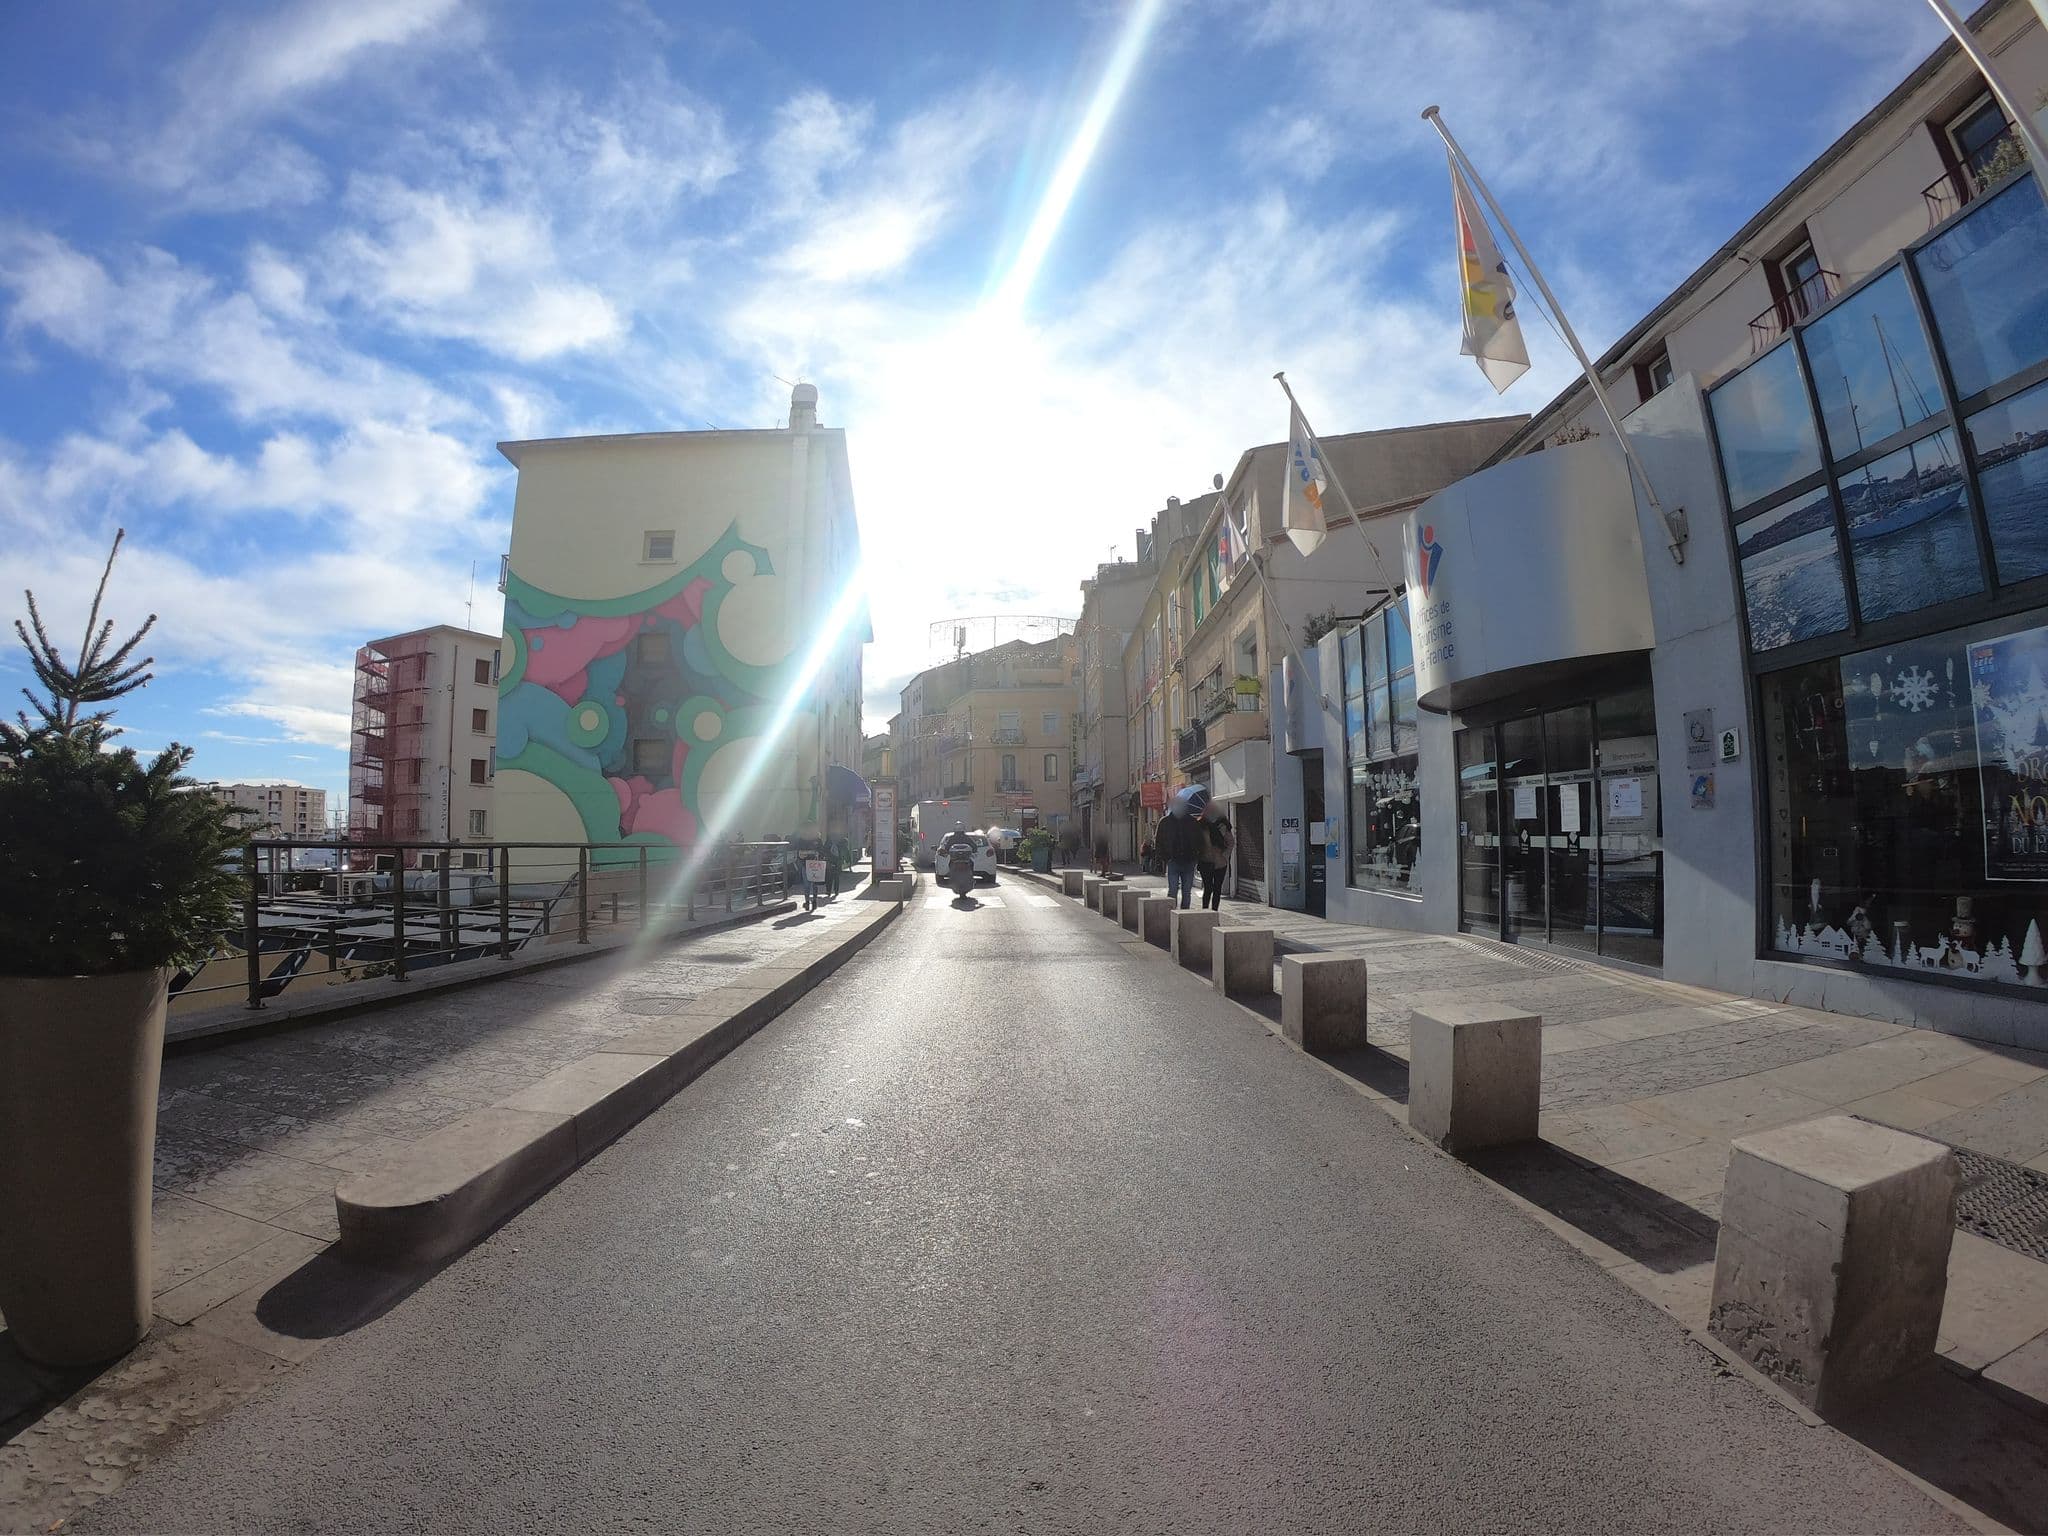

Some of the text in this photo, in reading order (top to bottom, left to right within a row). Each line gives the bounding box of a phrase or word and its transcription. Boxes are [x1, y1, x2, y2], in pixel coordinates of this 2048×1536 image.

[1440, 600, 1451, 614] de
[1417, 621, 1452, 648] Tourisme
[1425, 643, 1455, 668] France
[2012, 837, 2030, 854] DU
